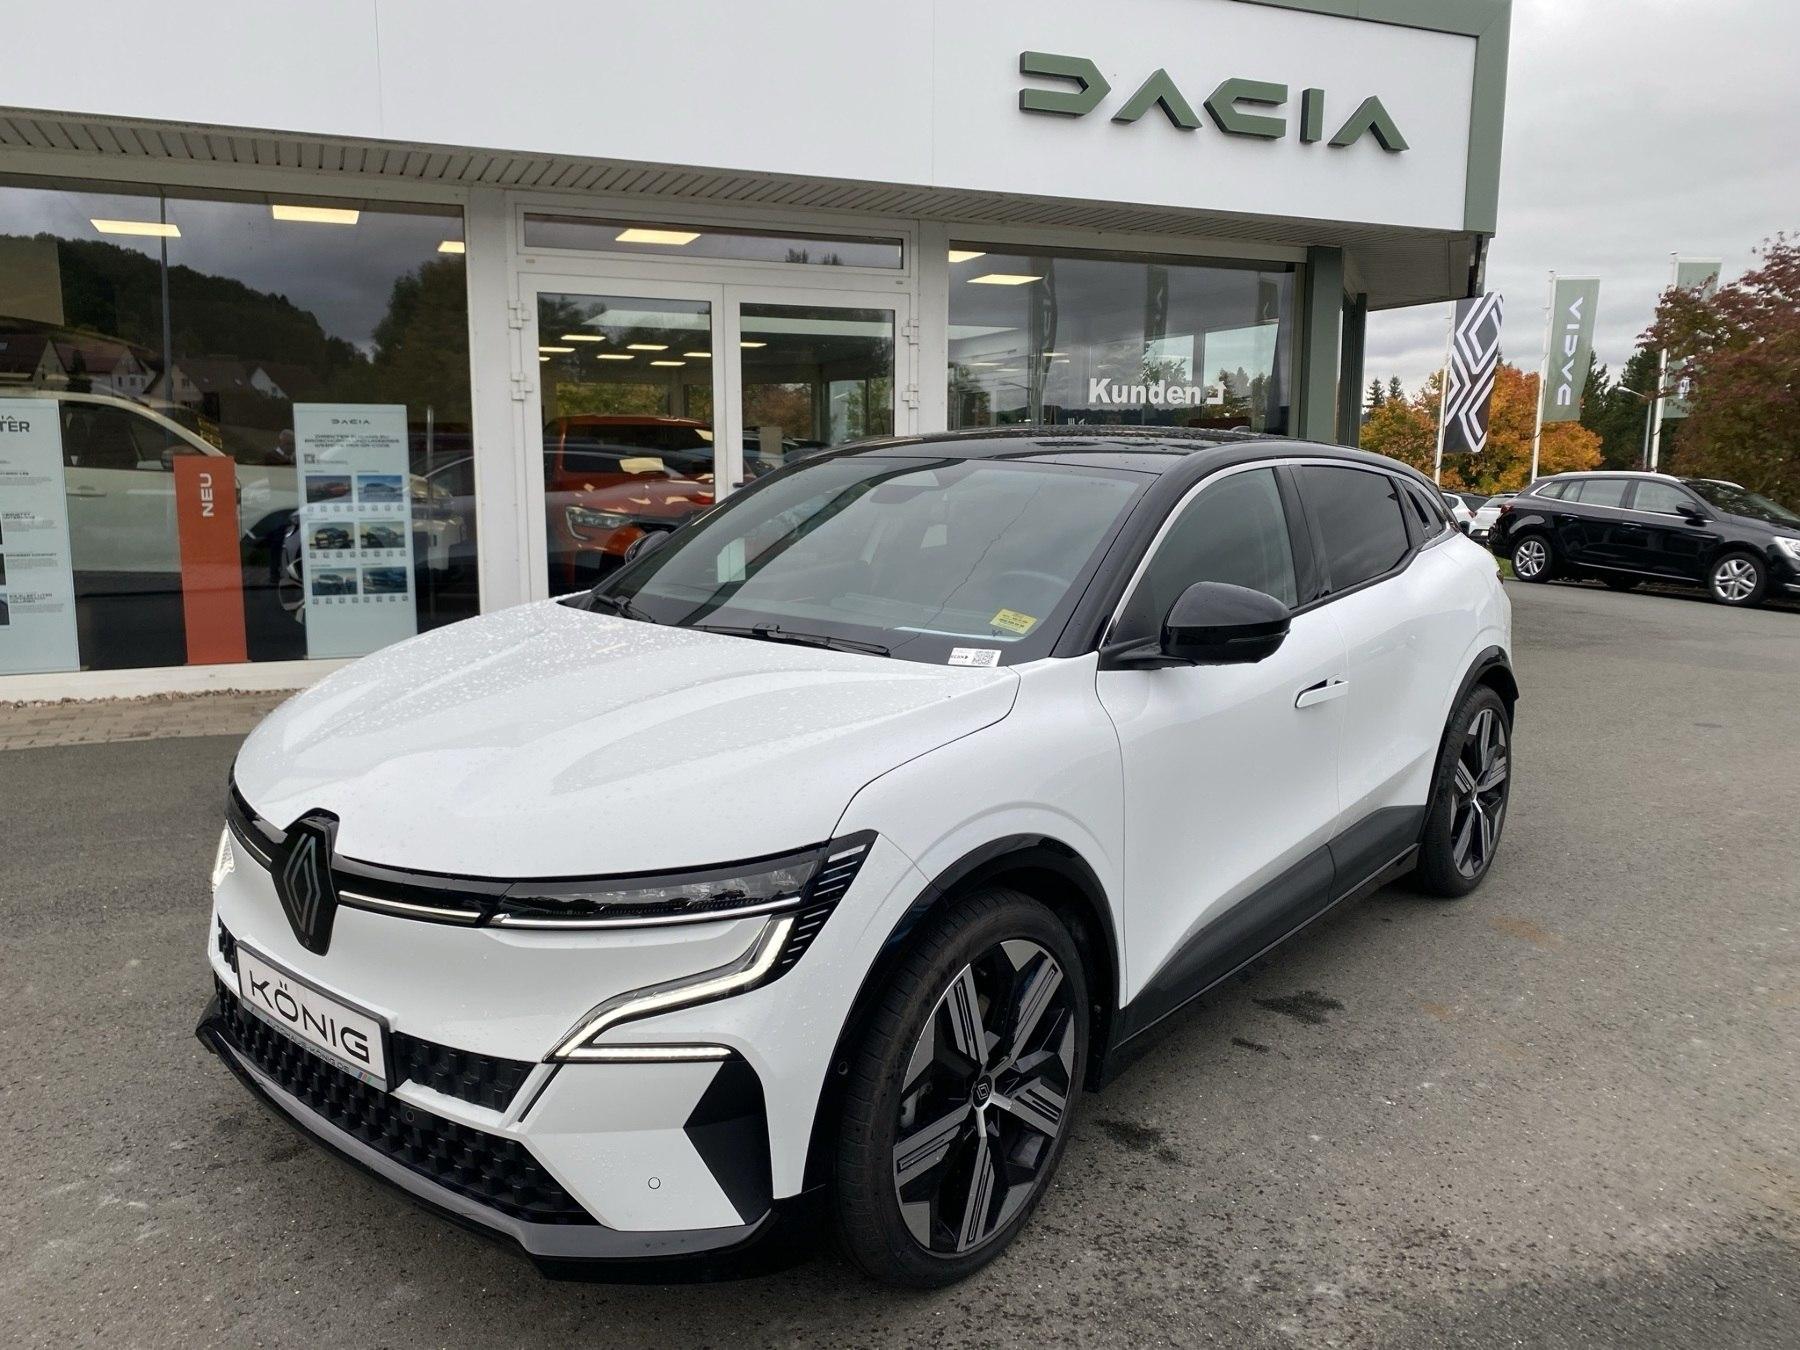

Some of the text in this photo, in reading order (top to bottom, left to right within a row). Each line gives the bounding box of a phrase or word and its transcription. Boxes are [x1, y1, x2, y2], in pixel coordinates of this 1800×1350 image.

[1019, 51, 1411, 153] DACIA
[1556, 296, 1584, 406] DACIA
[330, 418, 371, 426] DACIA
[1087, 377, 1202, 405] Kunden
[199, 472, 215, 518] NEU
[249, 969, 371, 1065] KÖNIG
